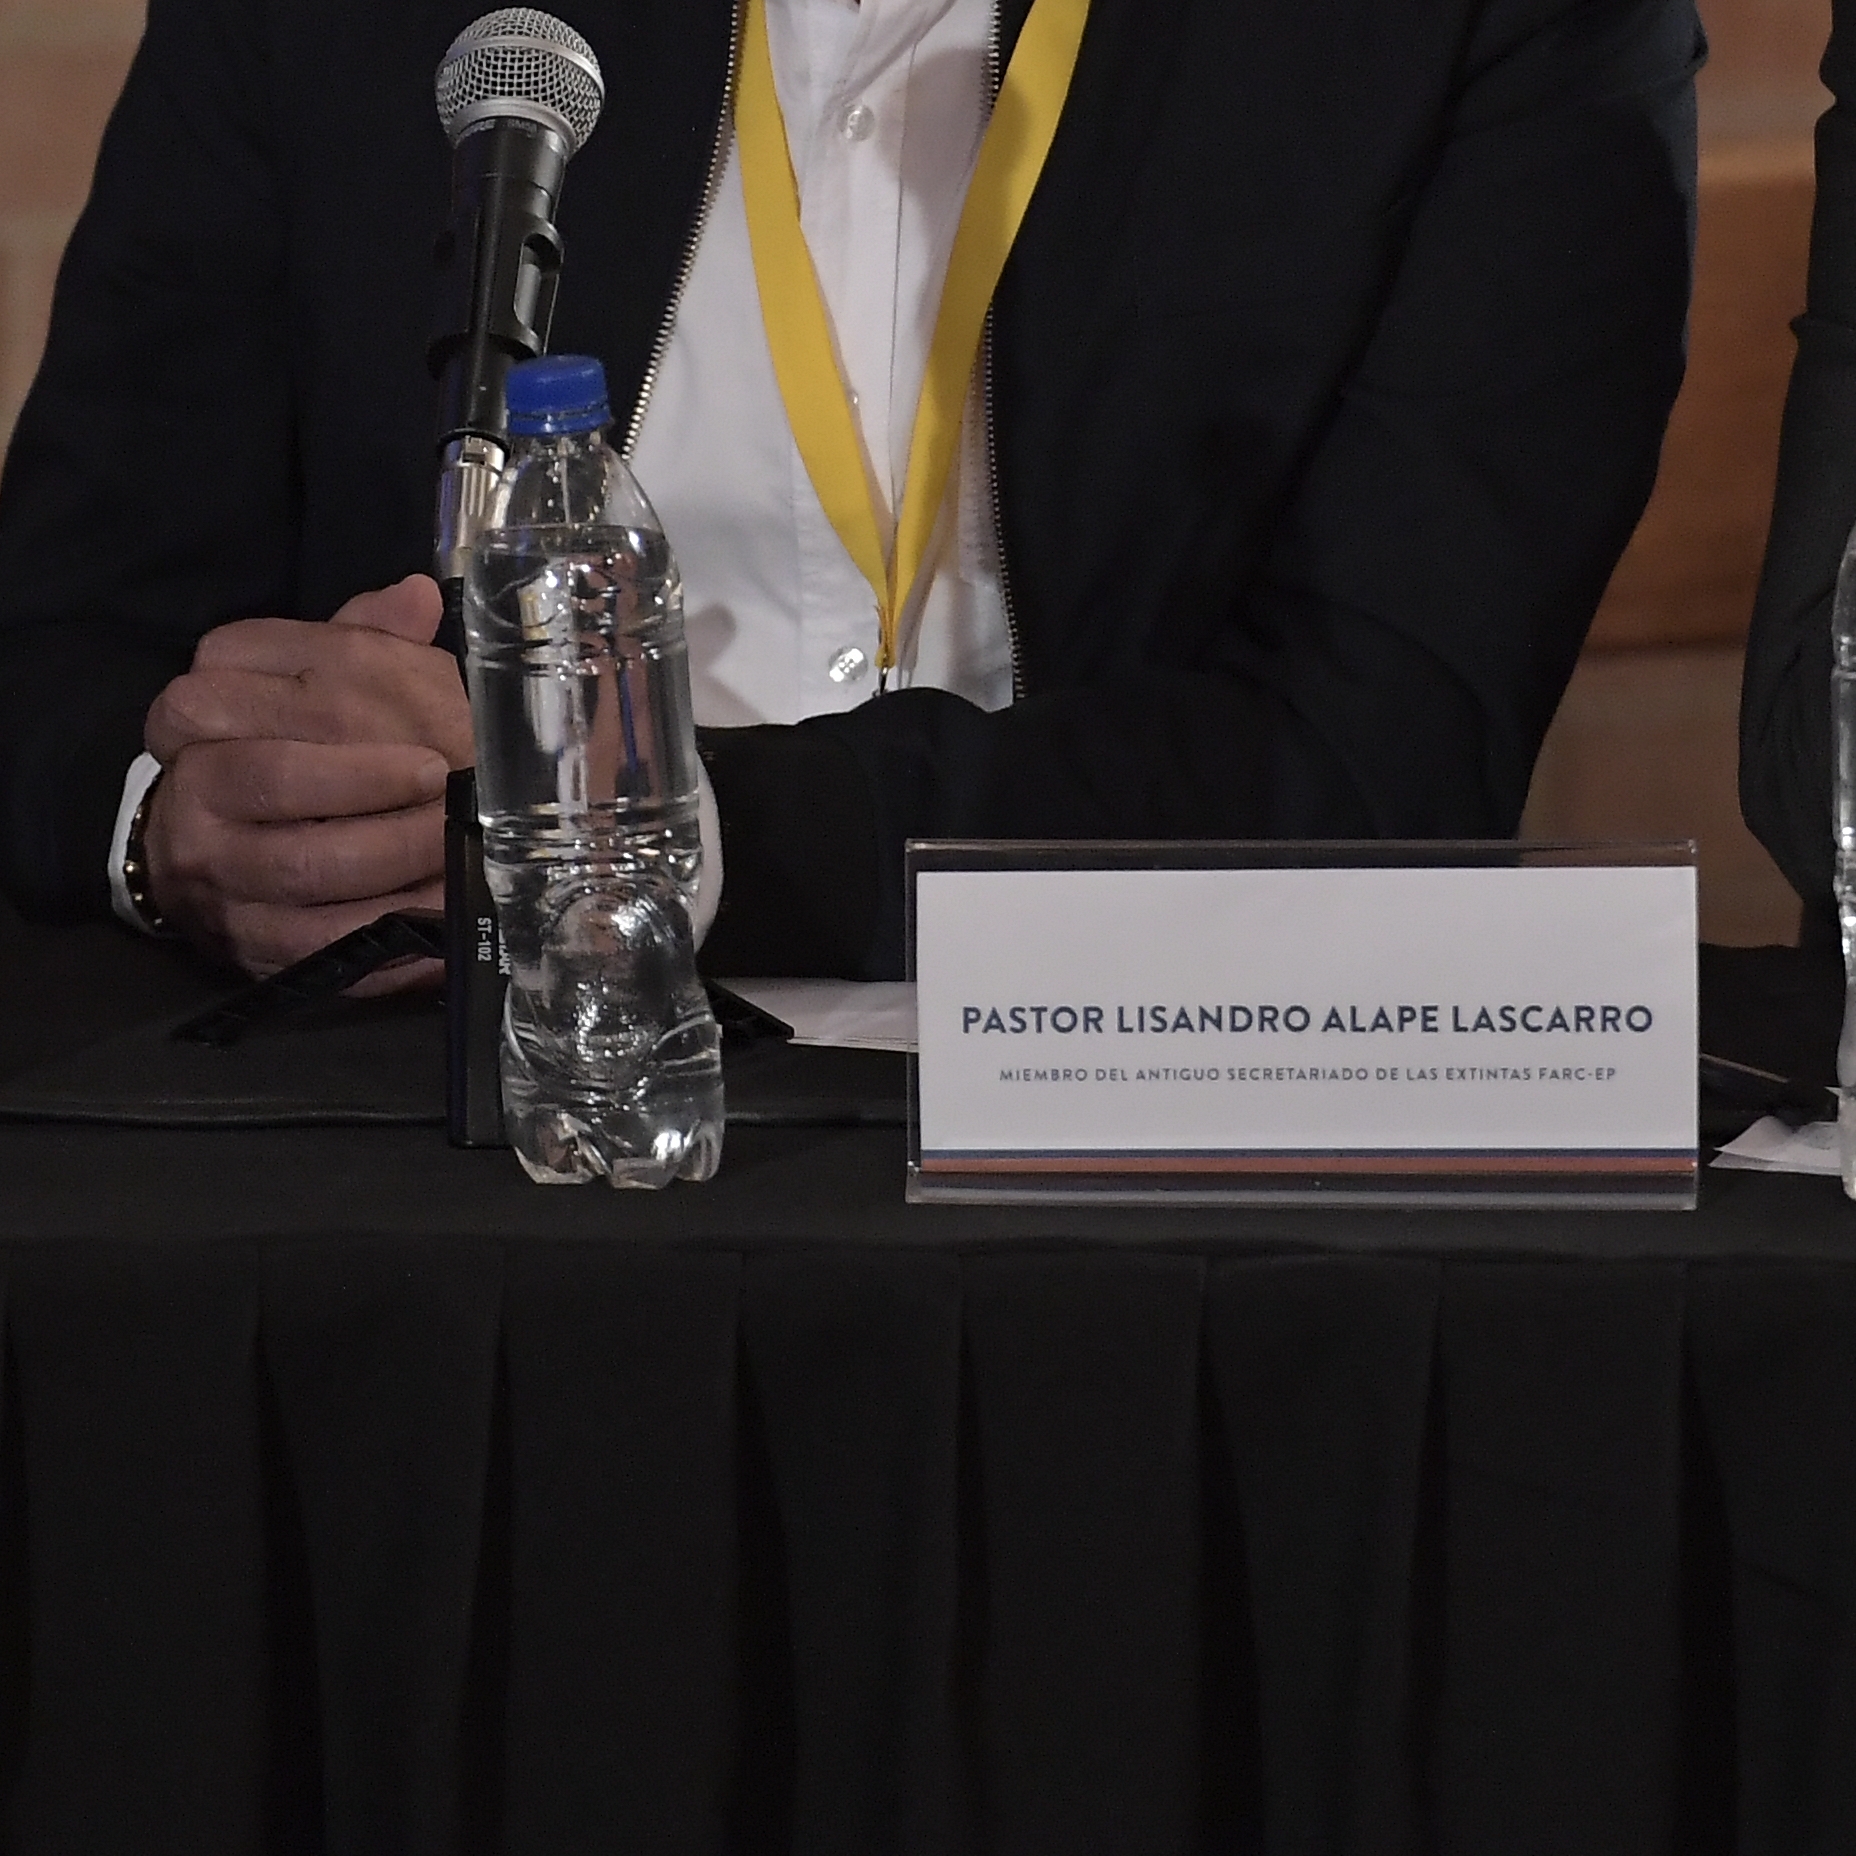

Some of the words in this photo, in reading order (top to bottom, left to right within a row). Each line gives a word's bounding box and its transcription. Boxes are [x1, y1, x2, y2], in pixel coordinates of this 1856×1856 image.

[476, 916, 493, 962] ST-102
[961, 1004, 1105, 1035] PASTOR
[1116, 1003, 1311, 1034] LISANDRO
[1319, 1003, 1440, 1034] ALAPE
[1450, 1003, 1653, 1034] LASCARRO
[998, 1067, 1088, 1082] MIEMBRO
[1094, 1066, 1129, 1082] DEL
[1134, 1066, 1220, 1082] ANTIGUO
[1225, 1066, 1369, 1082] SECRETARIADO
[1374, 1066, 1399, 1082] DE
[1405, 1066, 1439, 1082] LAS
[1444, 1065, 1532, 1081] EXTINTAS
[1537, 1065, 1617, 1082] FARC-EP
